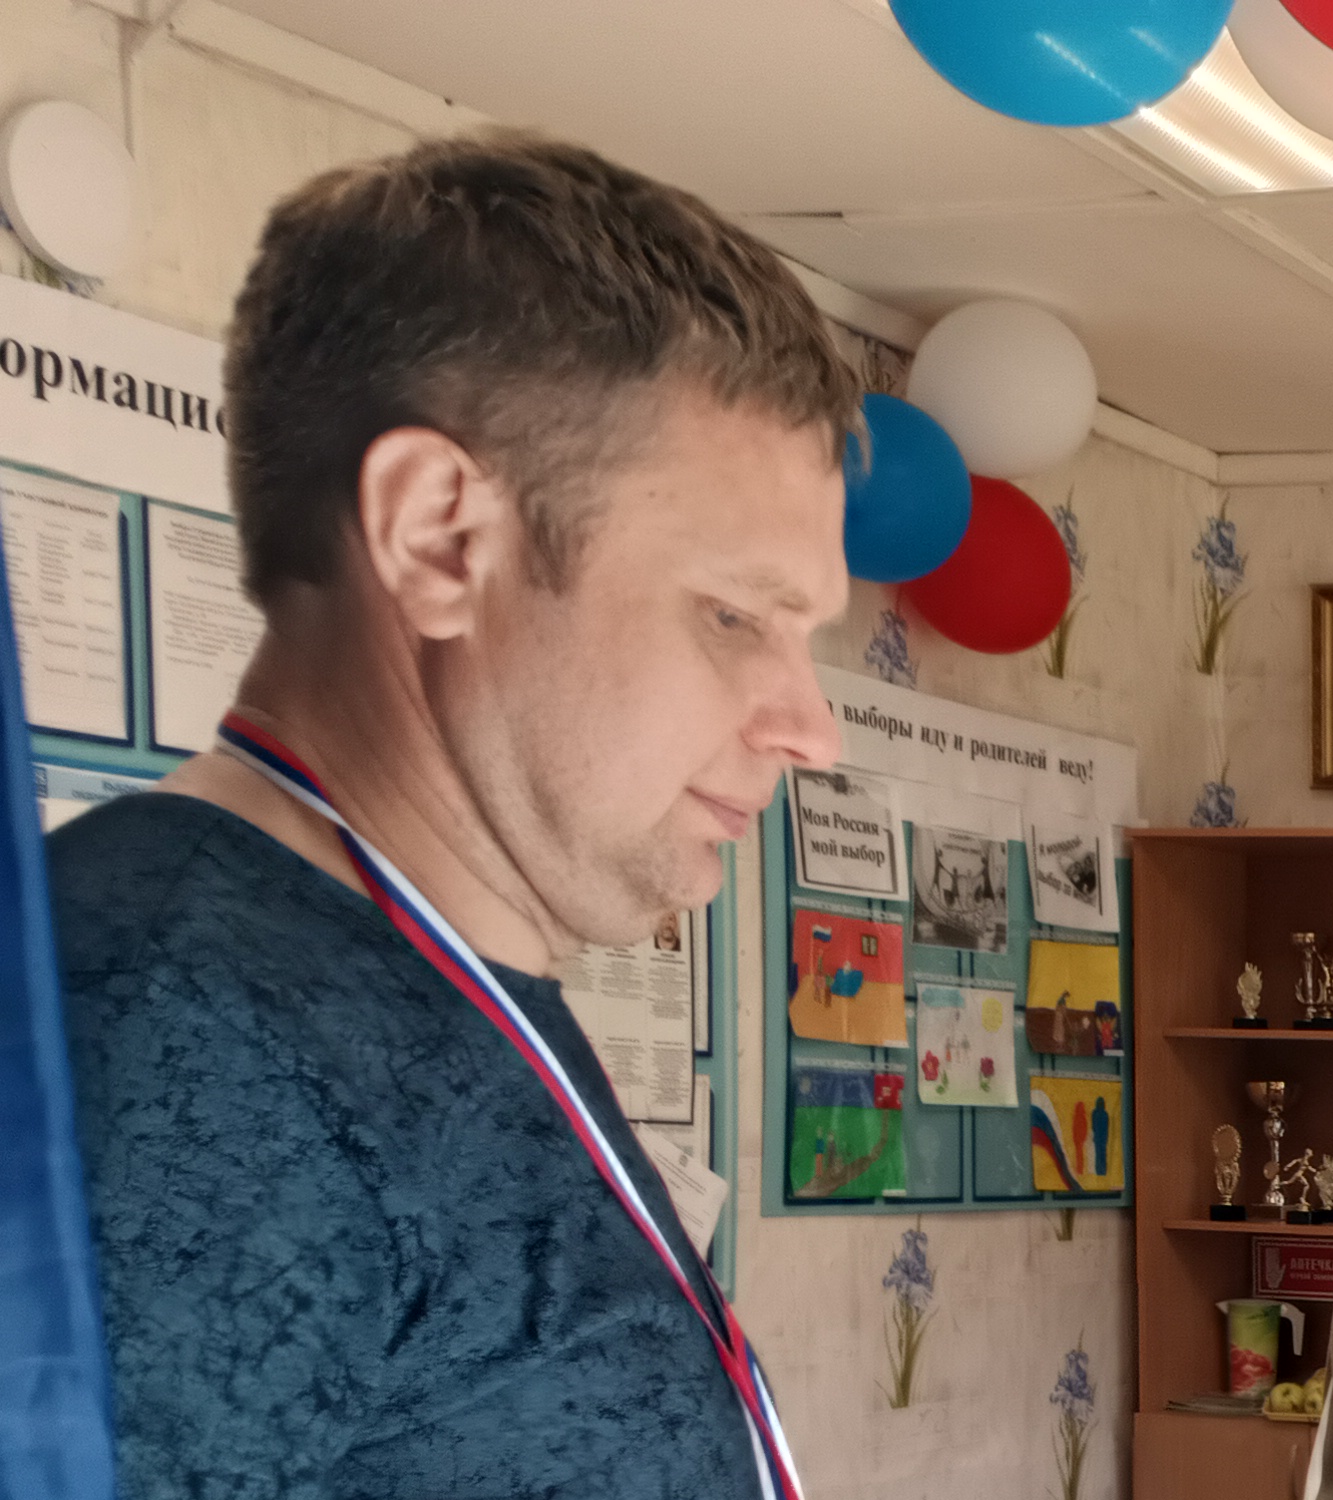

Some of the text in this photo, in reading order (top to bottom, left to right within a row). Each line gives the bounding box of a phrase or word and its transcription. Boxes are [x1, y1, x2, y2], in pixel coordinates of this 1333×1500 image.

[843, 702, 913, 741] выборы
[920, 724, 948, 754] иду
[954, 732, 963, 751] и
[970, 737, 1047, 771] родителей
[1059, 758, 1094, 785] веду!
[801, 806, 880, 837] Моя Россия
[811, 838, 886, 868] мой выбор
